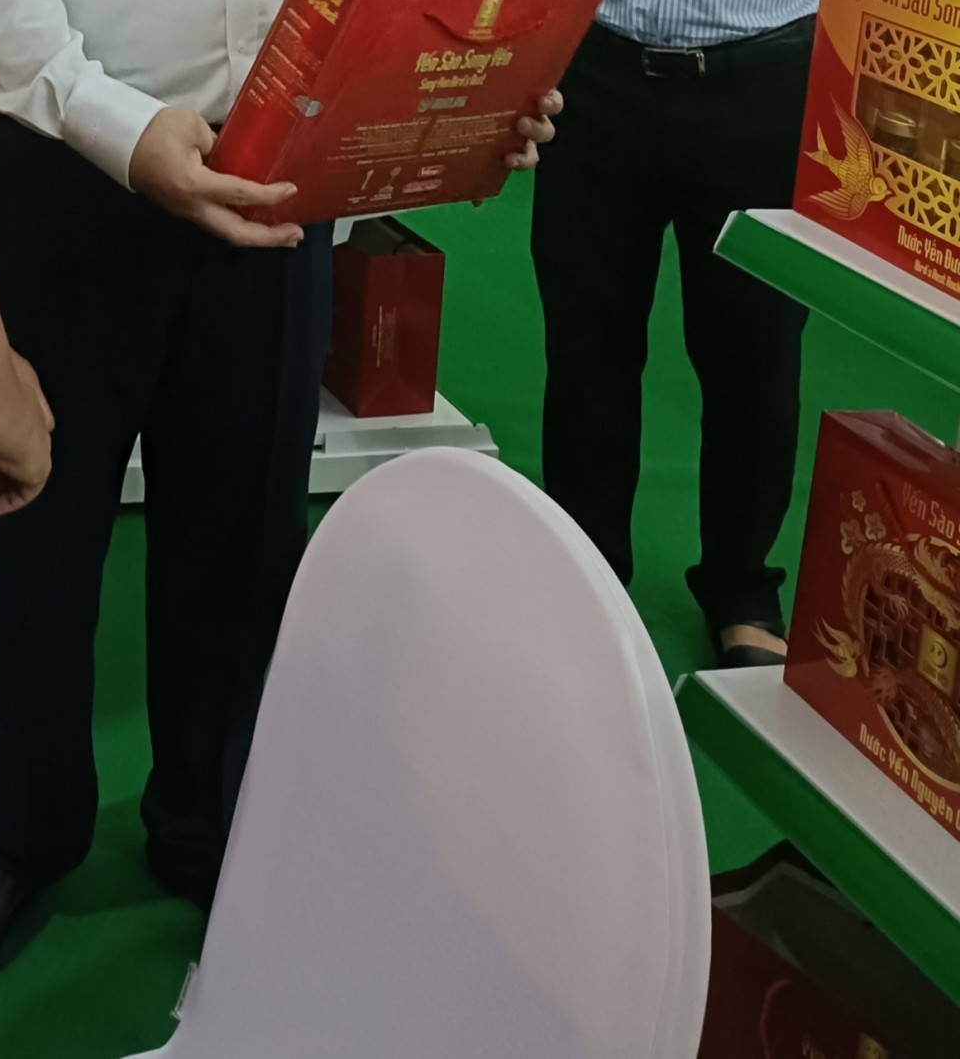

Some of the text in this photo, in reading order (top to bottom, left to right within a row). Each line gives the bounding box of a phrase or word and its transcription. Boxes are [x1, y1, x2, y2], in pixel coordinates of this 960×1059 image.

[897, 224, 923, 255] Nước
[924, 237, 943, 266] Yến
[928, 500, 955, 539] Sào
[860, 722, 886, 762] Nước
[910, 769, 954, 825] Nguyên
